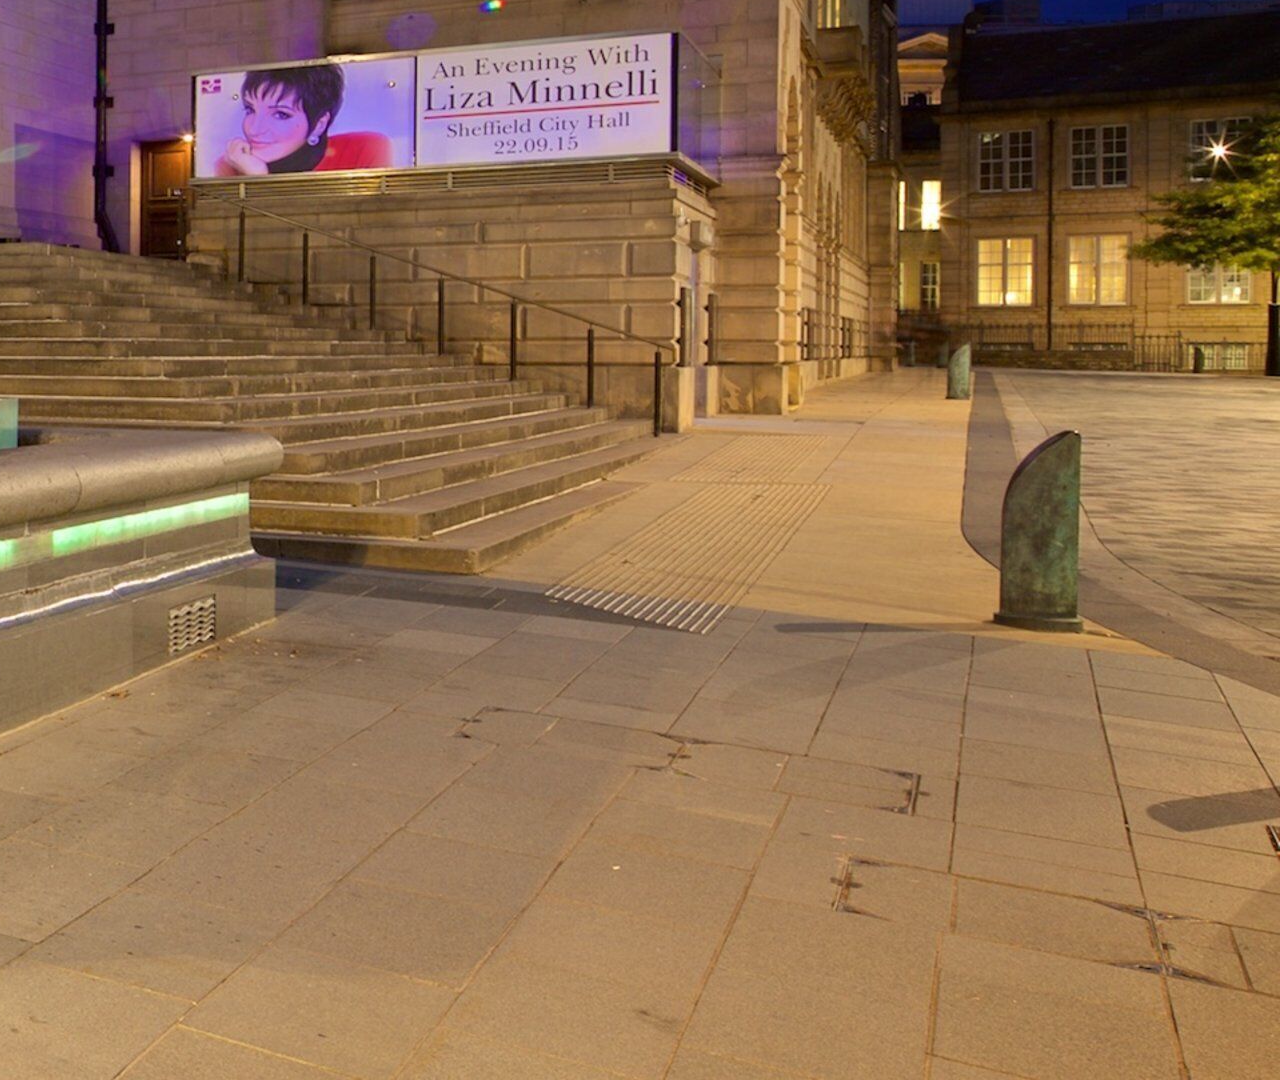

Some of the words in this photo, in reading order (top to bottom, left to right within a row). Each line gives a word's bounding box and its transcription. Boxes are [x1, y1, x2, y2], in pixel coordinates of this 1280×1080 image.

[432, 62, 465, 80] An
[475, 52, 578, 75] Evening
[587, 44, 650, 66] With
[424, 85, 494, 112] Liza
[507, 69, 660, 106] Minnelli
[446, 118, 532, 138] Sheffield
[539, 116, 580, 134] City
[587, 112, 630, 129] Hall
[494, 136, 579, 155] 22.09.15
